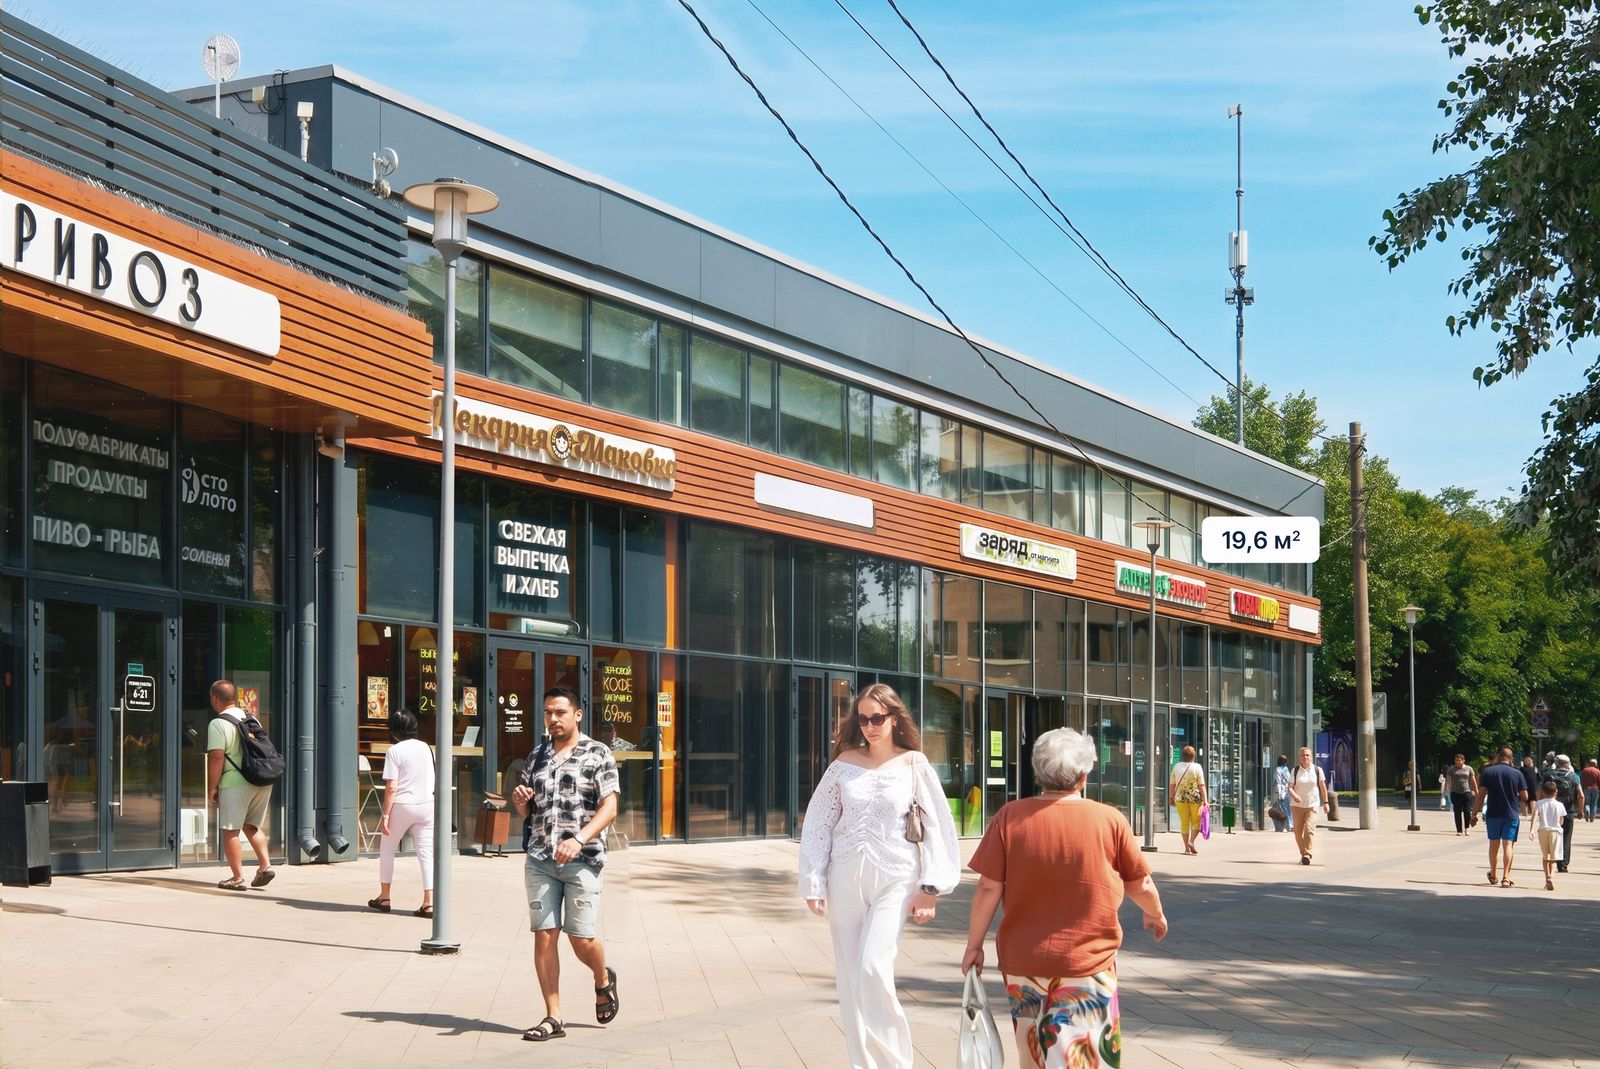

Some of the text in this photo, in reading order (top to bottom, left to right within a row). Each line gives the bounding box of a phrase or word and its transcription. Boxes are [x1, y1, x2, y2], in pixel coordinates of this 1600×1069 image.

[14, 203, 202, 322] РИВОЗ
[33, 420, 169, 469] ПОЛУФАБРИКАТЫ
[573, 430, 676, 479] Маковка
[53, 460, 148, 499] ПРОДУКТЫ
[200, 473, 228, 492] СТО
[200, 492, 237, 512] ЛОТО
[33, 515, 91, 548] ПИВО
[108, 529, 160, 560] РЫБА
[500, 519, 567, 549] СВЕЖАЯ
[979, 532, 1029, 560] заряд
[181, 546, 231, 567] СОЛЕНЬЯ
[496, 545, 571, 575] ВЫПЕЧКА
[505, 573, 560, 599] И ХЛЕБ
[1120, 567, 1163, 594] АПТЕА
[133, 689, 148, 699] 6-21
[603, 676, 633, 694] КОФЕ
